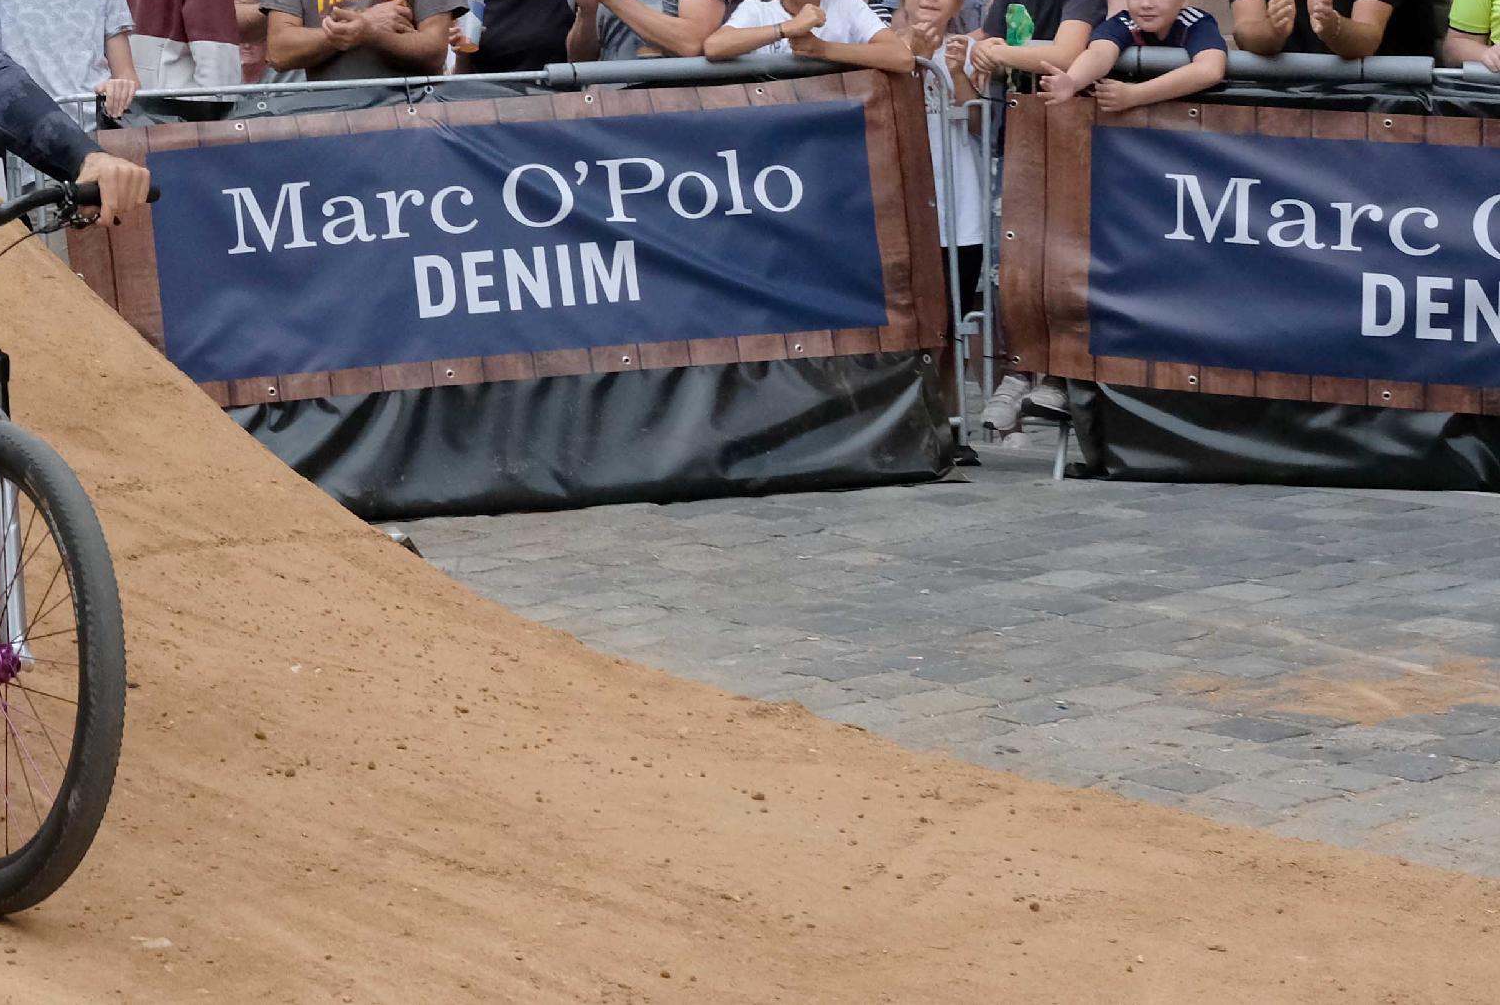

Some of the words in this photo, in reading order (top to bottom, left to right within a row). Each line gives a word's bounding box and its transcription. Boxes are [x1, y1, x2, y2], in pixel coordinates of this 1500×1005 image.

[222, 181, 479, 255] Marc
[502, 149, 803, 228] O'Polo
[1164, 173, 1441, 256] Marc
[413, 240, 641, 319] DENIM
